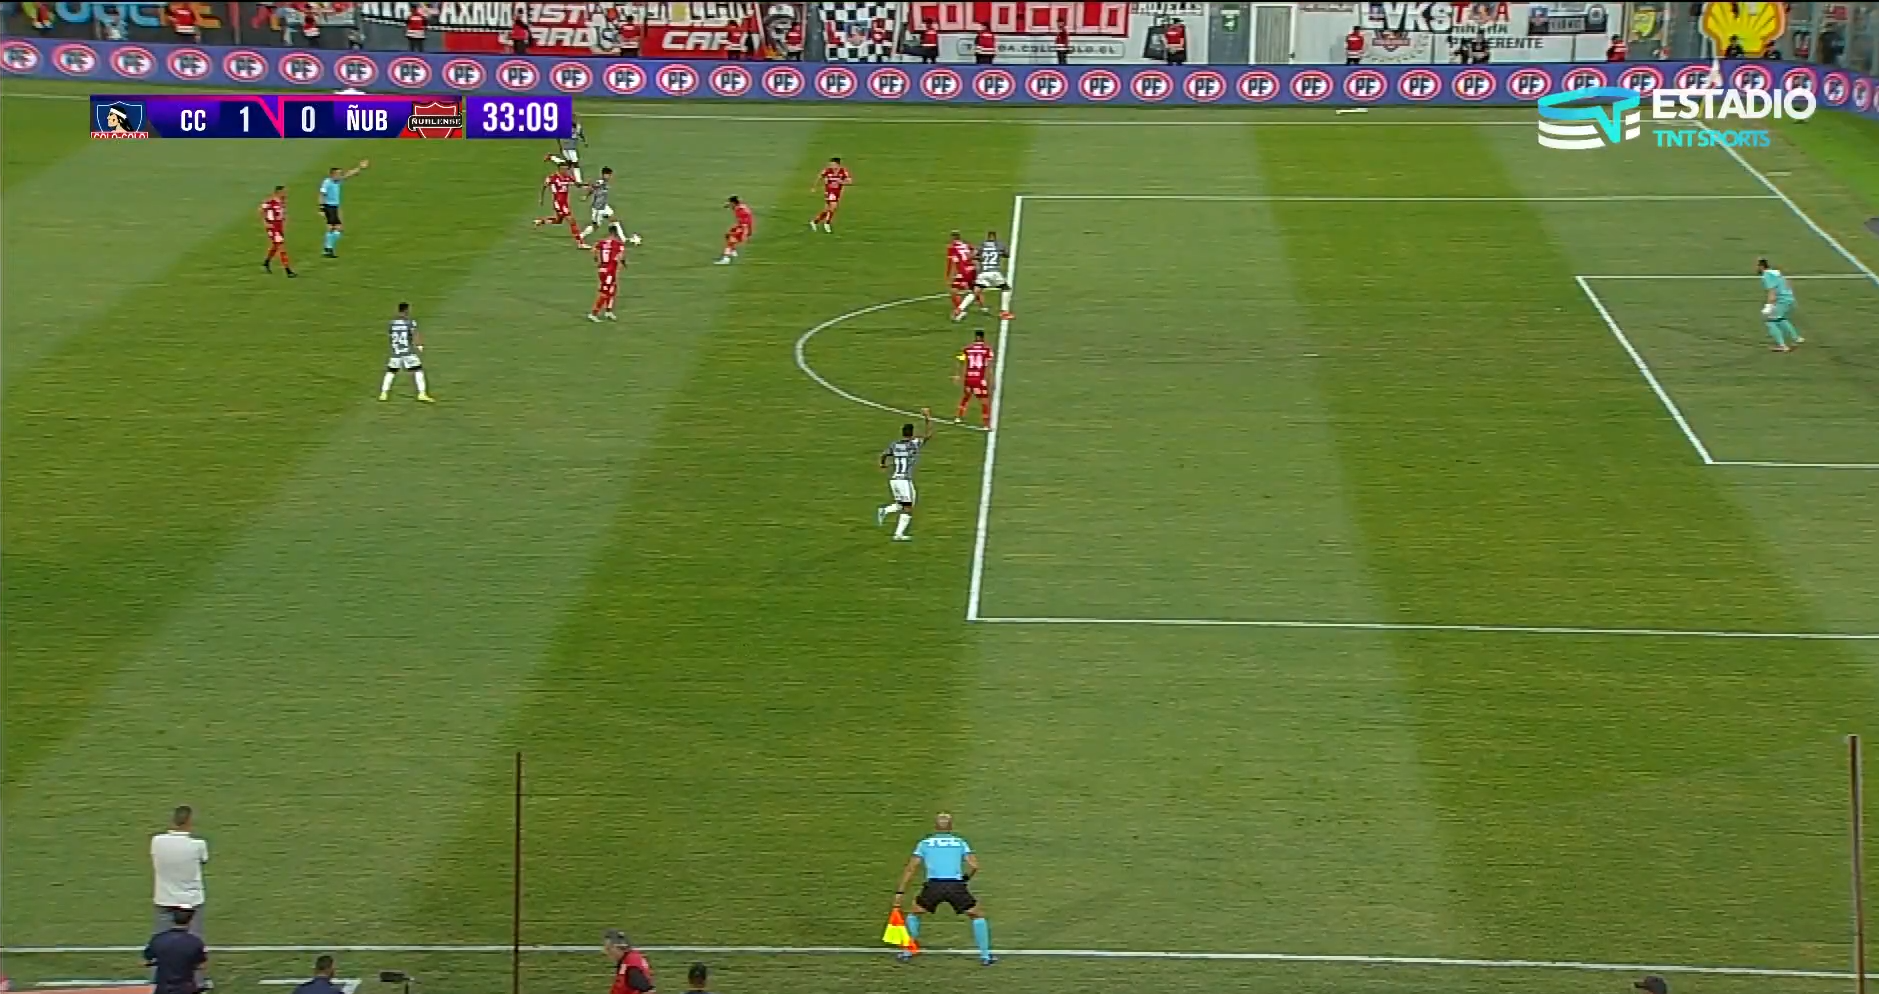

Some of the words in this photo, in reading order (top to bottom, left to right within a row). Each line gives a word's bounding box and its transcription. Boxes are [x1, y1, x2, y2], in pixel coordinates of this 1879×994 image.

[179, 55, 200, 74] PF
[236, 58, 256, 76] PF
[291, 60, 311, 77] PF
[346, 63, 366, 80] PF
[400, 64, 420, 81] PF
[455, 66, 474, 83] PF
[509, 68, 528, 85] PF
[562, 70, 581, 86] PF
[615, 71, 635, 87] PF
[668, 72, 688, 88] PF
[721, 73, 741, 90] PF
[774, 74, 793, 90] PF
[827, 74, 846, 91] PF
[1631, 73, 1652, 90] PF
[880, 76, 899, 92] PF
[932, 76, 951, 92] PF
[985, 76, 1004, 93] PF
[1038, 78, 1056, 94] PF
[1090, 78, 1109, 94] PF
[1142, 78, 1161, 94] PF
[1195, 78, 1215, 94] PF
[1249, 78, 1268, 94] PF
[1302, 78, 1321, 94] PF
[1356, 78, 1375, 94] PF
[1410, 78, 1429, 94] PF
[1464, 77, 1484, 94] PF
[1519, 76, 1539, 92] PF
[982, 251, 998, 265] 22
[391, 331, 408, 348] 24
[967, 353, 984, 368] 14
